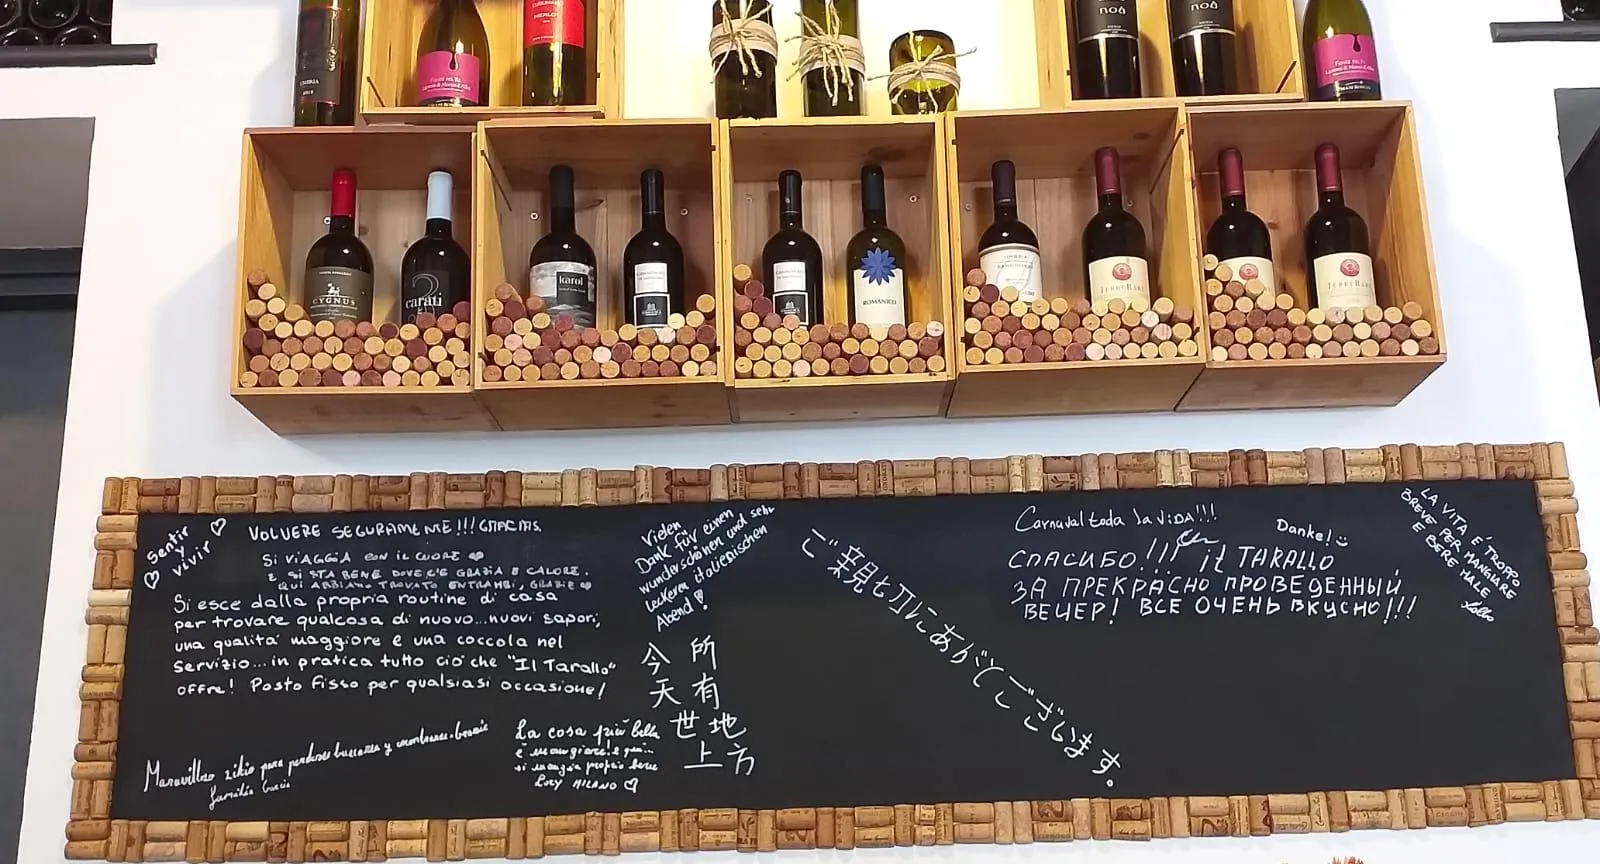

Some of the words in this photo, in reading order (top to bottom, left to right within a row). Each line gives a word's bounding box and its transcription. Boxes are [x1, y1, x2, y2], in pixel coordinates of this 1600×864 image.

[559, 275, 584, 286] karol
[312, 297, 356, 306] CYGNUS
[405, 292, 443, 309] carati
[862, 298, 897, 306] ROMANICO
[1088, 508, 1126, 529] toda
[1132, 507, 1153, 526] la
[249, 523, 321, 542] VOLVERE
[634, 543, 673, 575] Dank
[674, 528, 698, 552] für
[702, 508, 735, 536] einen
[640, 520, 683, 547] Vielen
[1276, 518, 1332, 547] Danke!
[1400, 487, 1438, 525] BREVE
[1439, 527, 1462, 553] PER
[1463, 550, 1518, 600] MANGIARE
[1420, 487, 1439, 507] LA
[1441, 502, 1468, 536] VITA
[1484, 544, 1521, 588] TROPPO
[171, 539, 211, 578] vivir
[638, 535, 725, 595] wunderschönen
[726, 512, 749, 540] und
[749, 504, 776, 519] sehr
[692, 524, 769, 584] italienischen
[1238, 546, 1335, 571] TARALLO
[1411, 521, 1426, 533] E
[1425, 534, 1460, 568] BERE
[1459, 568, 1492, 599] MALE
[341, 569, 382, 581] BENE
[392, 568, 423, 578] DOVE
[174, 592, 192, 613] Si
[197, 599, 242, 611] esce
[250, 594, 308, 610] dalla
[316, 593, 390, 612] propria
[398, 591, 468, 606] routine
[480, 588, 498, 605] di
[508, 591, 559, 602] casa
[1010, 575, 1048, 605] ЗА
[1061, 575, 1211, 601] ПРЕКРАСНО
[174, 619, 207, 634] per
[211, 614, 291, 628] trovare
[296, 611, 384, 632] qualcosa
[391, 612, 412, 625] di
[1023, 597, 1120, 625] ВЕЧЕР!
[1139, 597, 1183, 617] ВСЕ
[1194, 595, 1282, 616] ОЧЕНЬ
[174, 641, 206, 653] una
[290, 633, 382, 652] maggiore
[392, 634, 403, 647] e
[413, 634, 447, 646] una
[456, 633, 529, 647] coccola
[537, 634, 564, 648] nel
[297, 653, 374, 672] pratica
[379, 652, 425, 668] tutto
[469, 654, 499, 668] che
[177, 677, 235, 696] offre!
[249, 676, 303, 693] Posto
[367, 679, 400, 697] per
[405, 672, 491, 694] qualsiasi
[500, 680, 607, 700] occasione!
[515, 718, 542, 740] La
[547, 725, 588, 738] cosa
[631, 719, 661, 740] bella
[383, 742, 393, 757] y
[572, 778, 618, 791] MILANO
